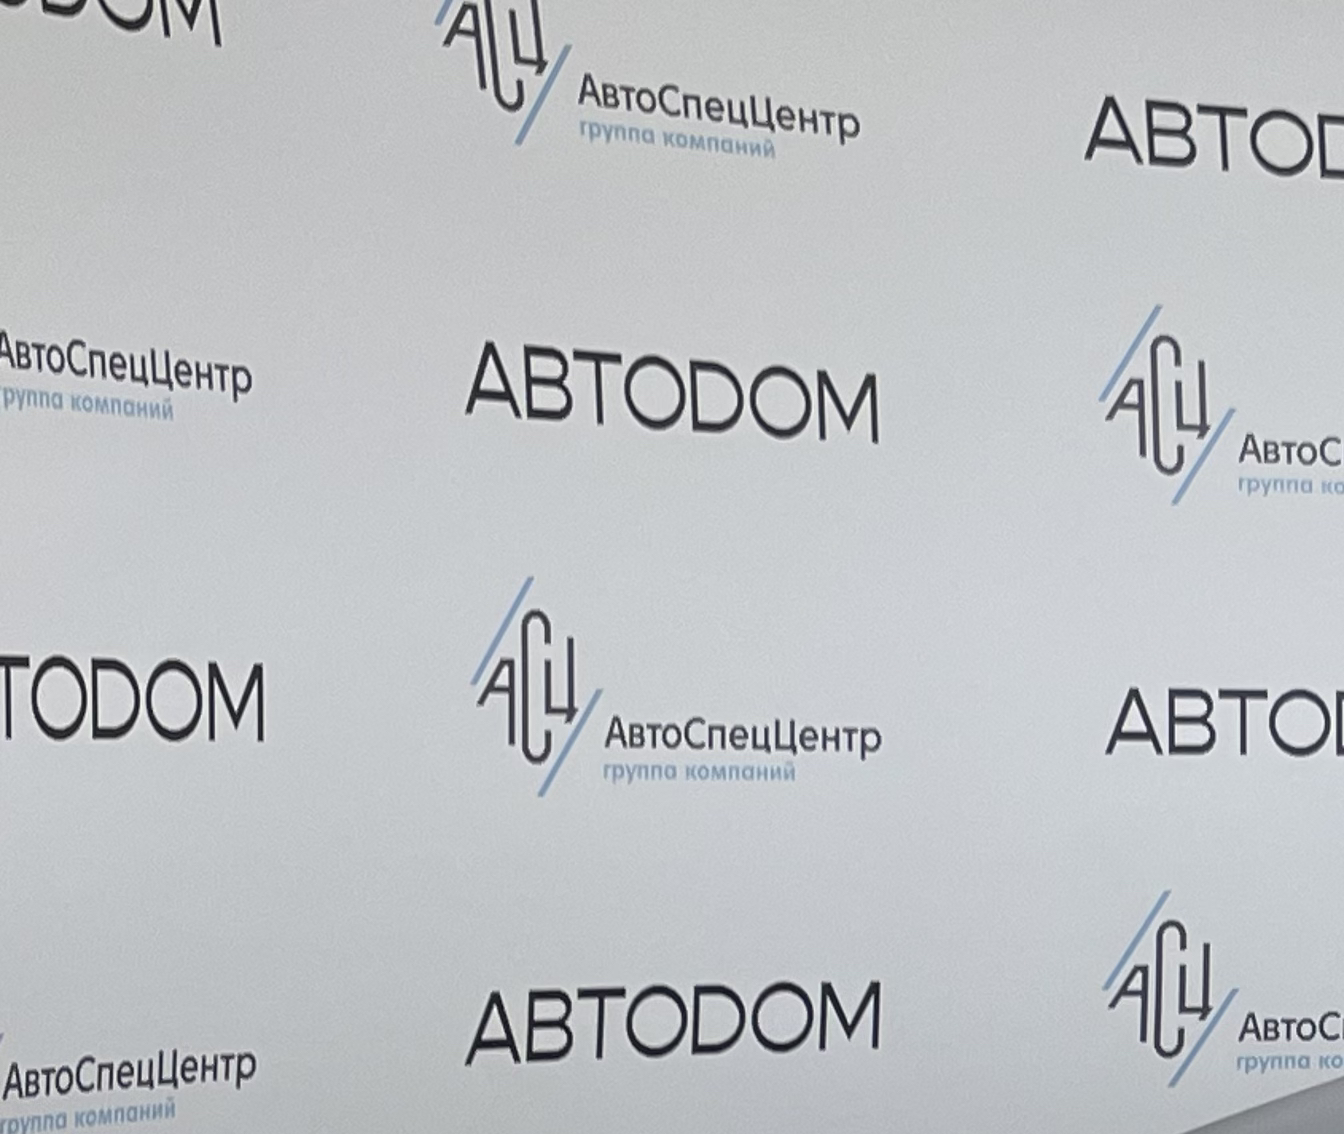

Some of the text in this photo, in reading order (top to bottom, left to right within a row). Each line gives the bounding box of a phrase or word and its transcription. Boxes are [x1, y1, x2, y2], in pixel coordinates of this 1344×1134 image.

[577, 73, 861, 145] АвтоСпецЦентр
[579, 118, 776, 158] группа компаний
[70, 391, 175, 422] компаний
[465, 340, 879, 445] ABTODOM
[1237, 476, 1313, 497] группа
[604, 715, 883, 761] АвтоСпецЦентр
[602, 761, 797, 785] группа компаний
[464, 980, 881, 1067] ABTODOM
[2, 1048, 258, 1101] АвтоСпецЦентр
[1236, 1053, 1312, 1074] группа
[74, 1096, 177, 1128] компаний
